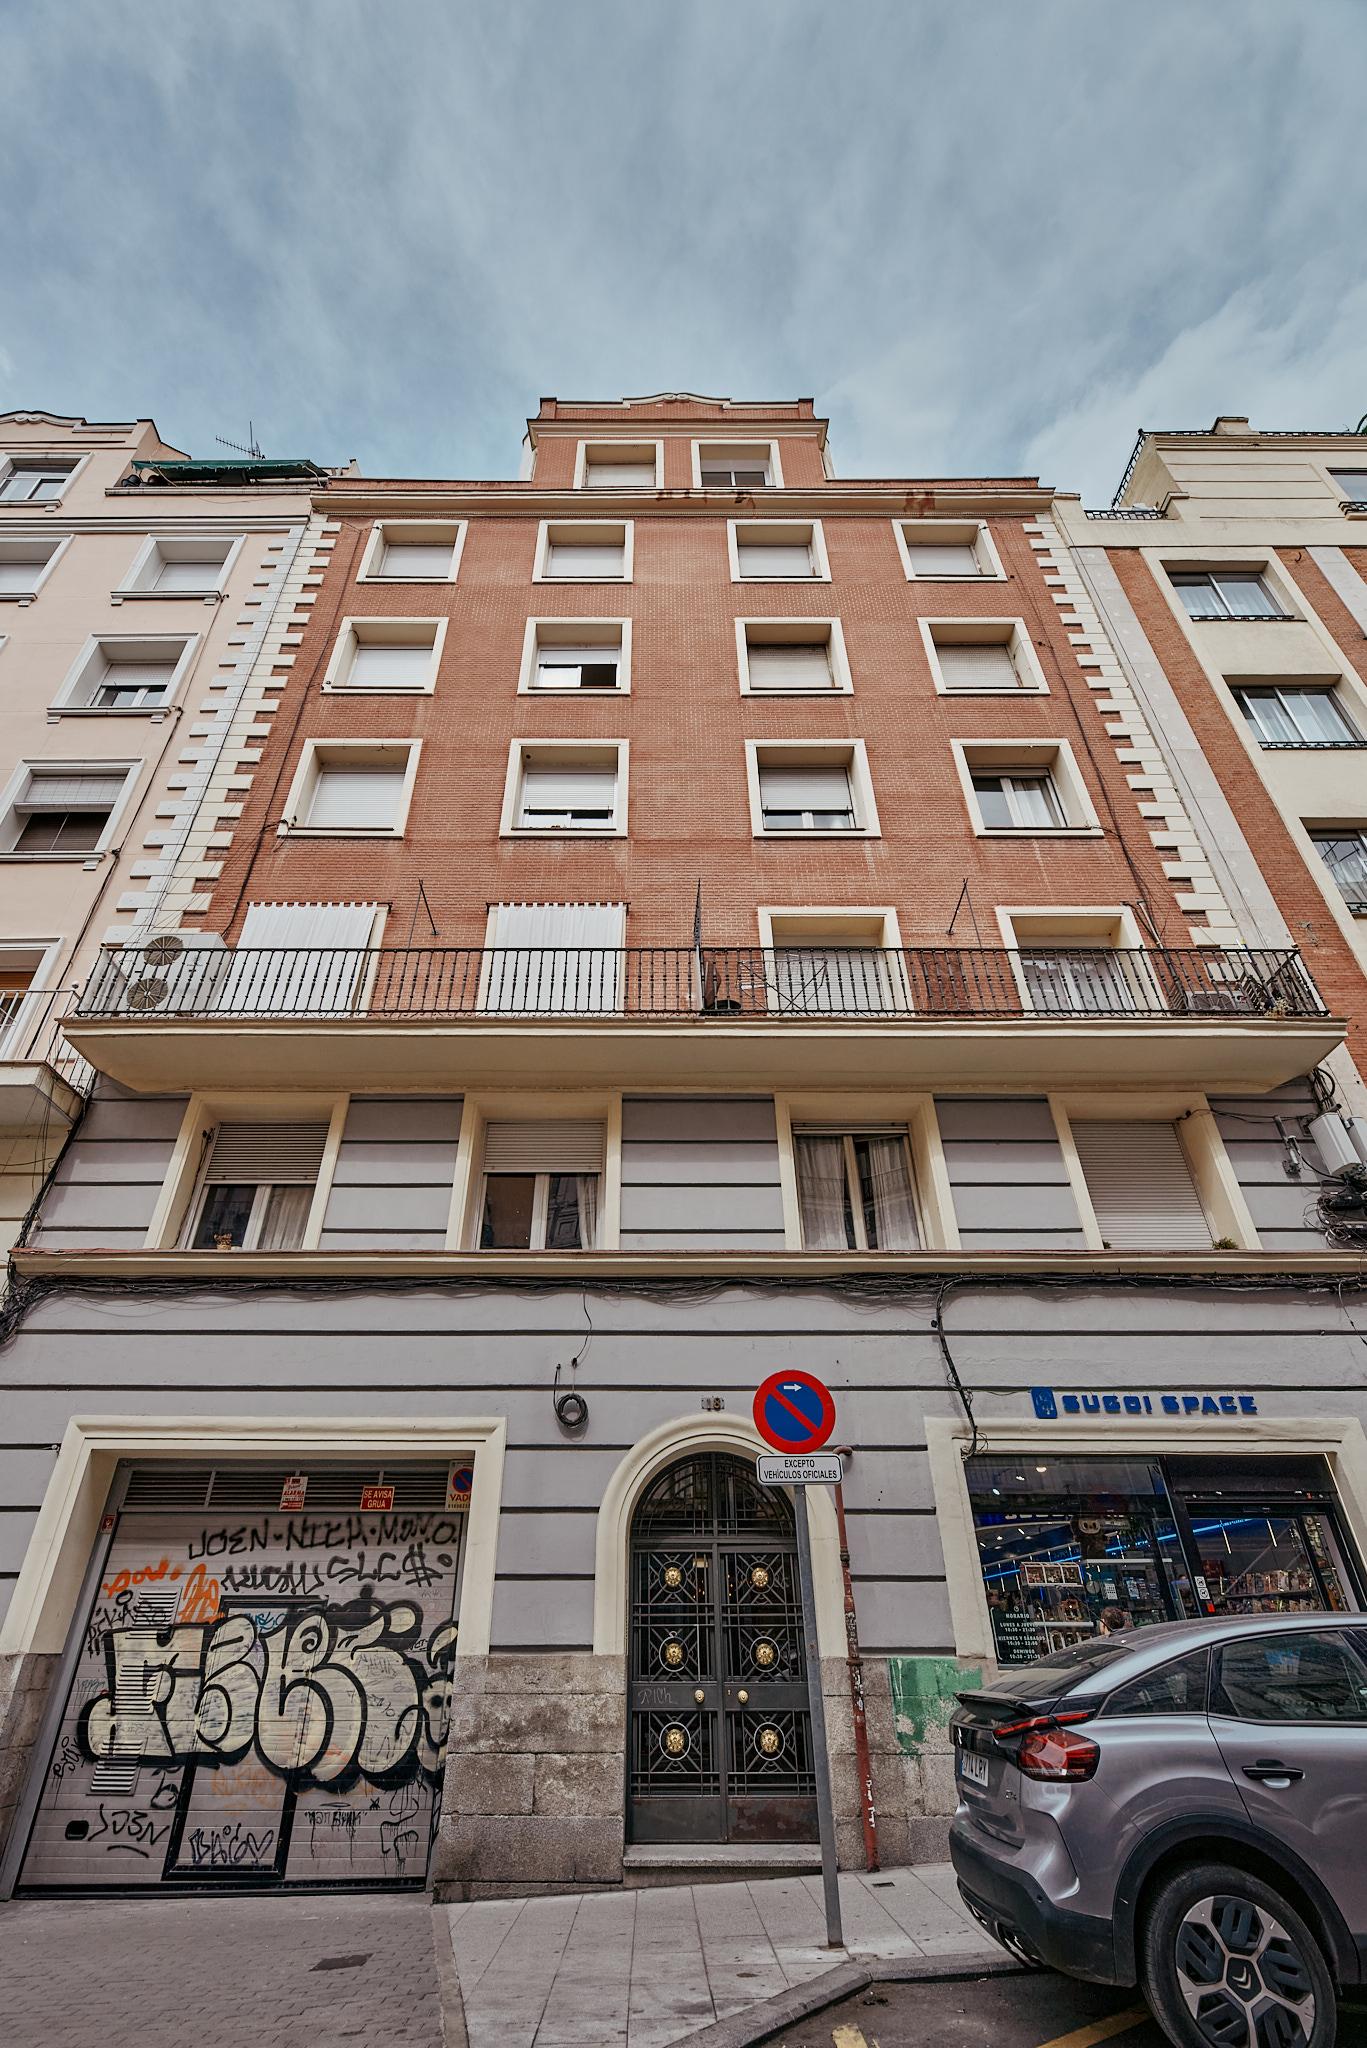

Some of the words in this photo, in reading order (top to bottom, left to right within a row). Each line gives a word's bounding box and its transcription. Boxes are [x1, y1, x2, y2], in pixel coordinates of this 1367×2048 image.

[1062, 1395, 1152, 1413] SUGOI
[1161, 1395, 1257, 1414] SPACE
[784, 1459, 815, 1468] EXCEPTO
[763, 1469, 802, 1479] VEHÍCULOS
[802, 1470, 837, 1479] OFICIALES
[363, 1490, 373, 1499] SE
[373, 1490, 392, 1498] AVISA
[449, 1493, 471, 1501] VAD
[367, 1499, 386, 1508] GRUA
